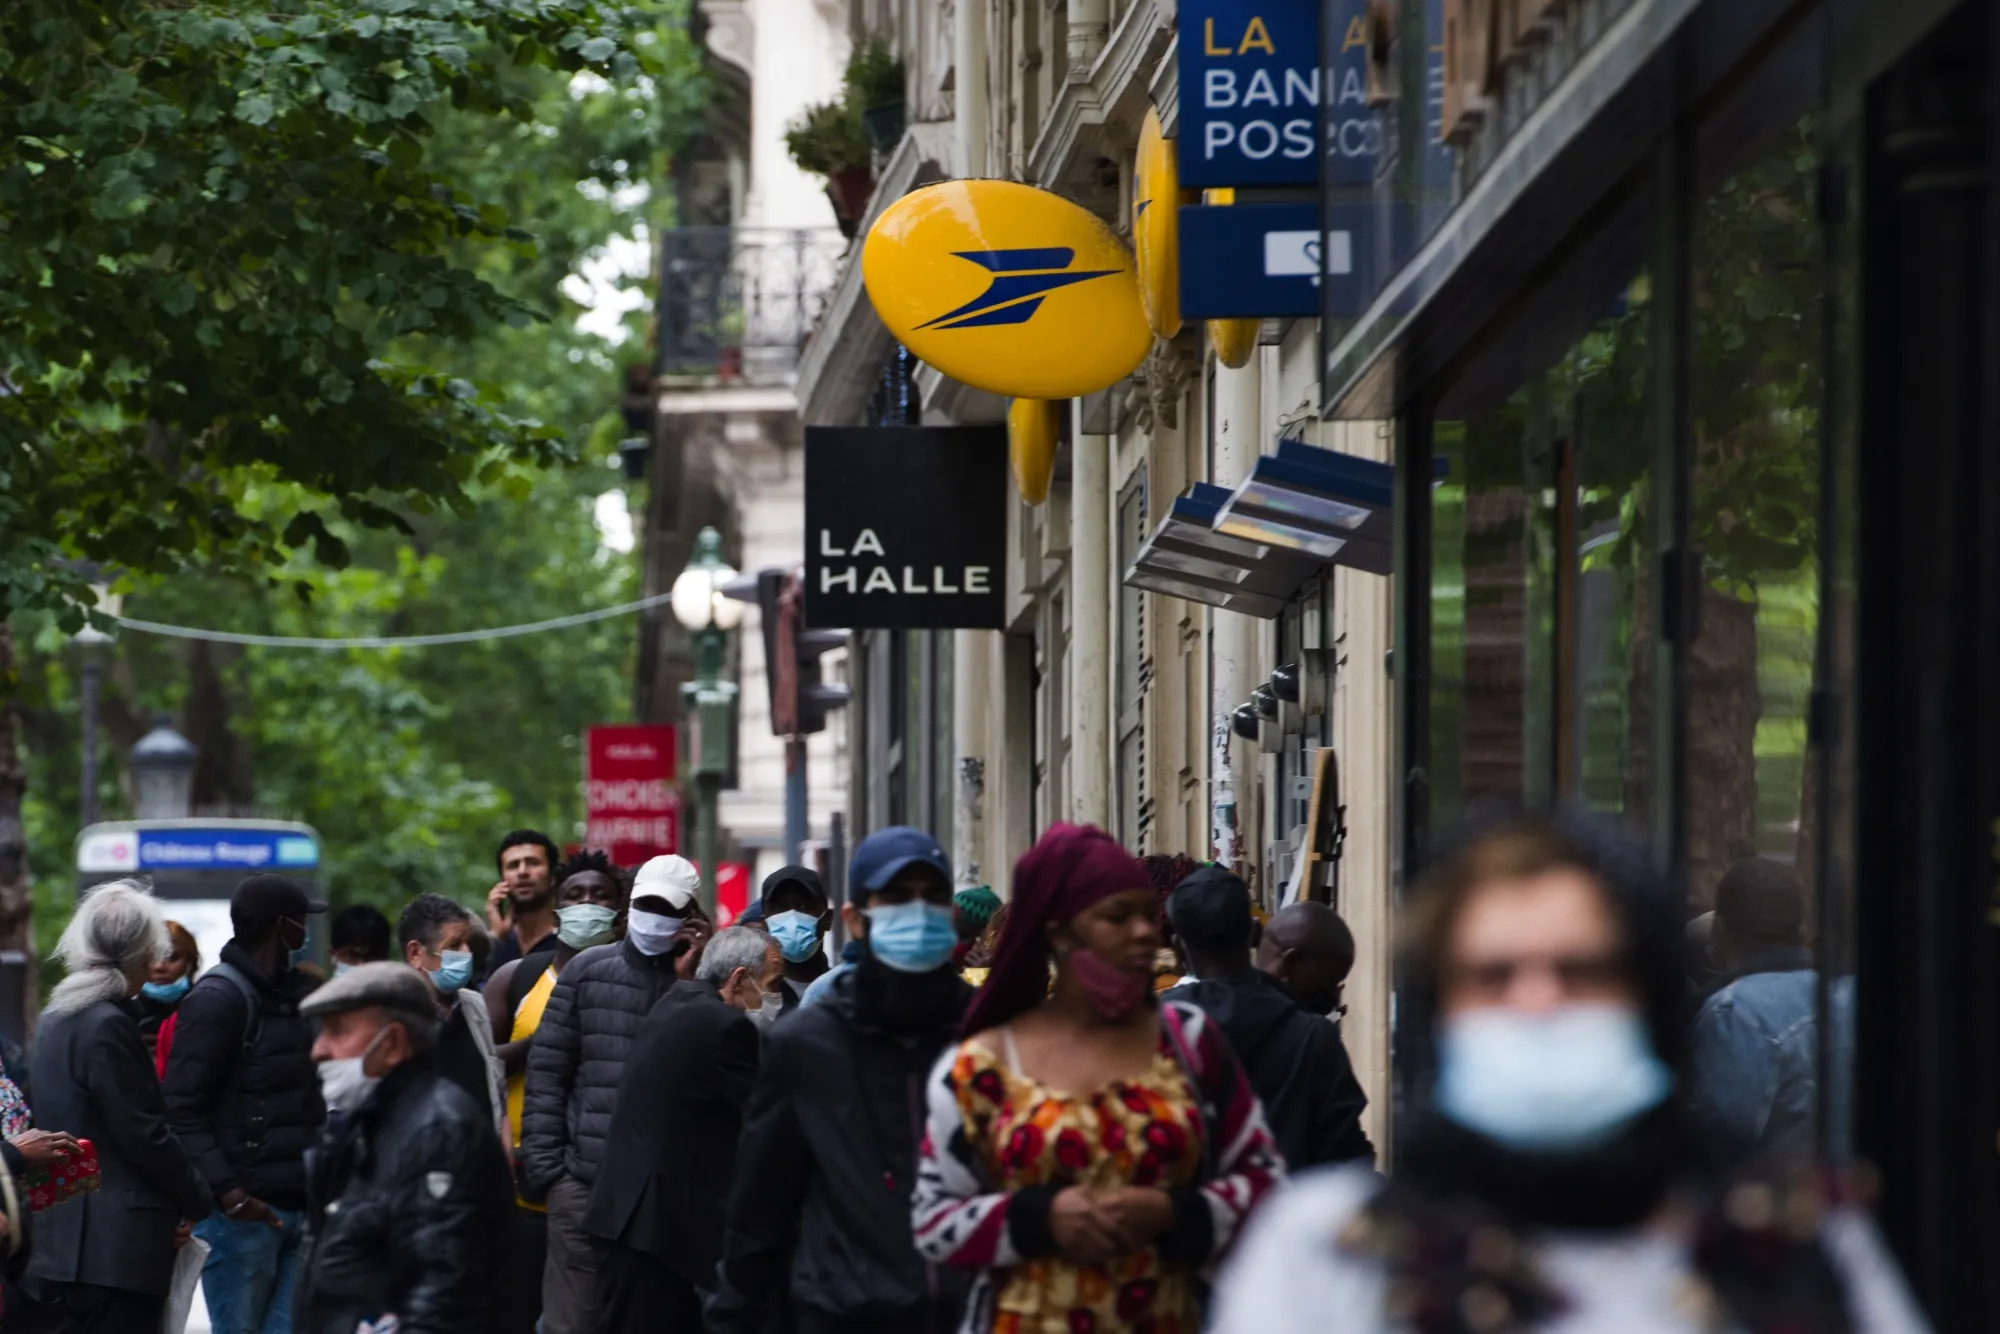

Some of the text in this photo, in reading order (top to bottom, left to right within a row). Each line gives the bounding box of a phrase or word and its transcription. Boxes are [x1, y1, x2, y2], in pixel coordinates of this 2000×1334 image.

[1204, 16, 1276, 56] LA
[820, 528, 885, 556] LA
[820, 565, 991, 594] HALLE
